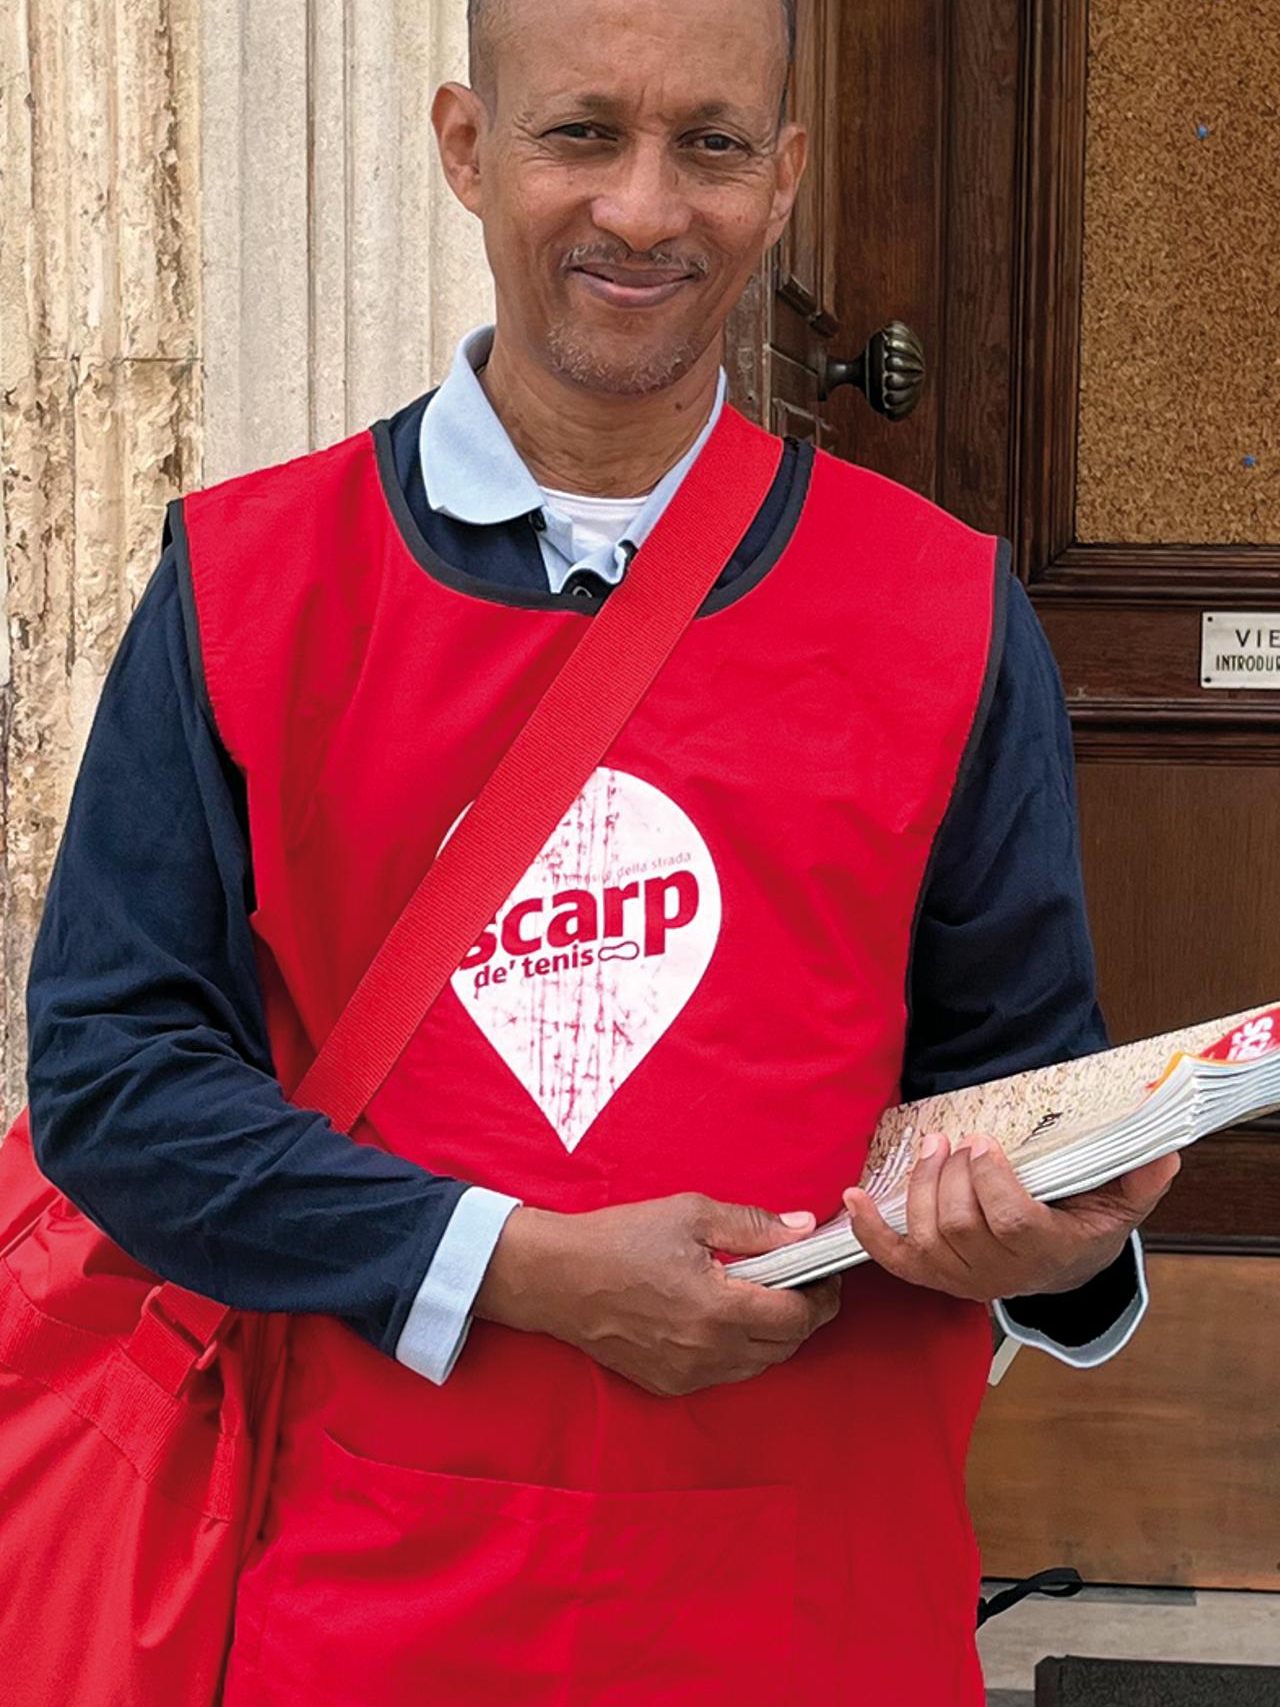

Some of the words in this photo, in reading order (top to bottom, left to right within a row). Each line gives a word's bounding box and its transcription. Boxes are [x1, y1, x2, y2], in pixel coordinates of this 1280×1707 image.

[651, 851, 692, 870] strada
[459, 870, 700, 970] scarp
[521, 943, 594, 979] tenis
